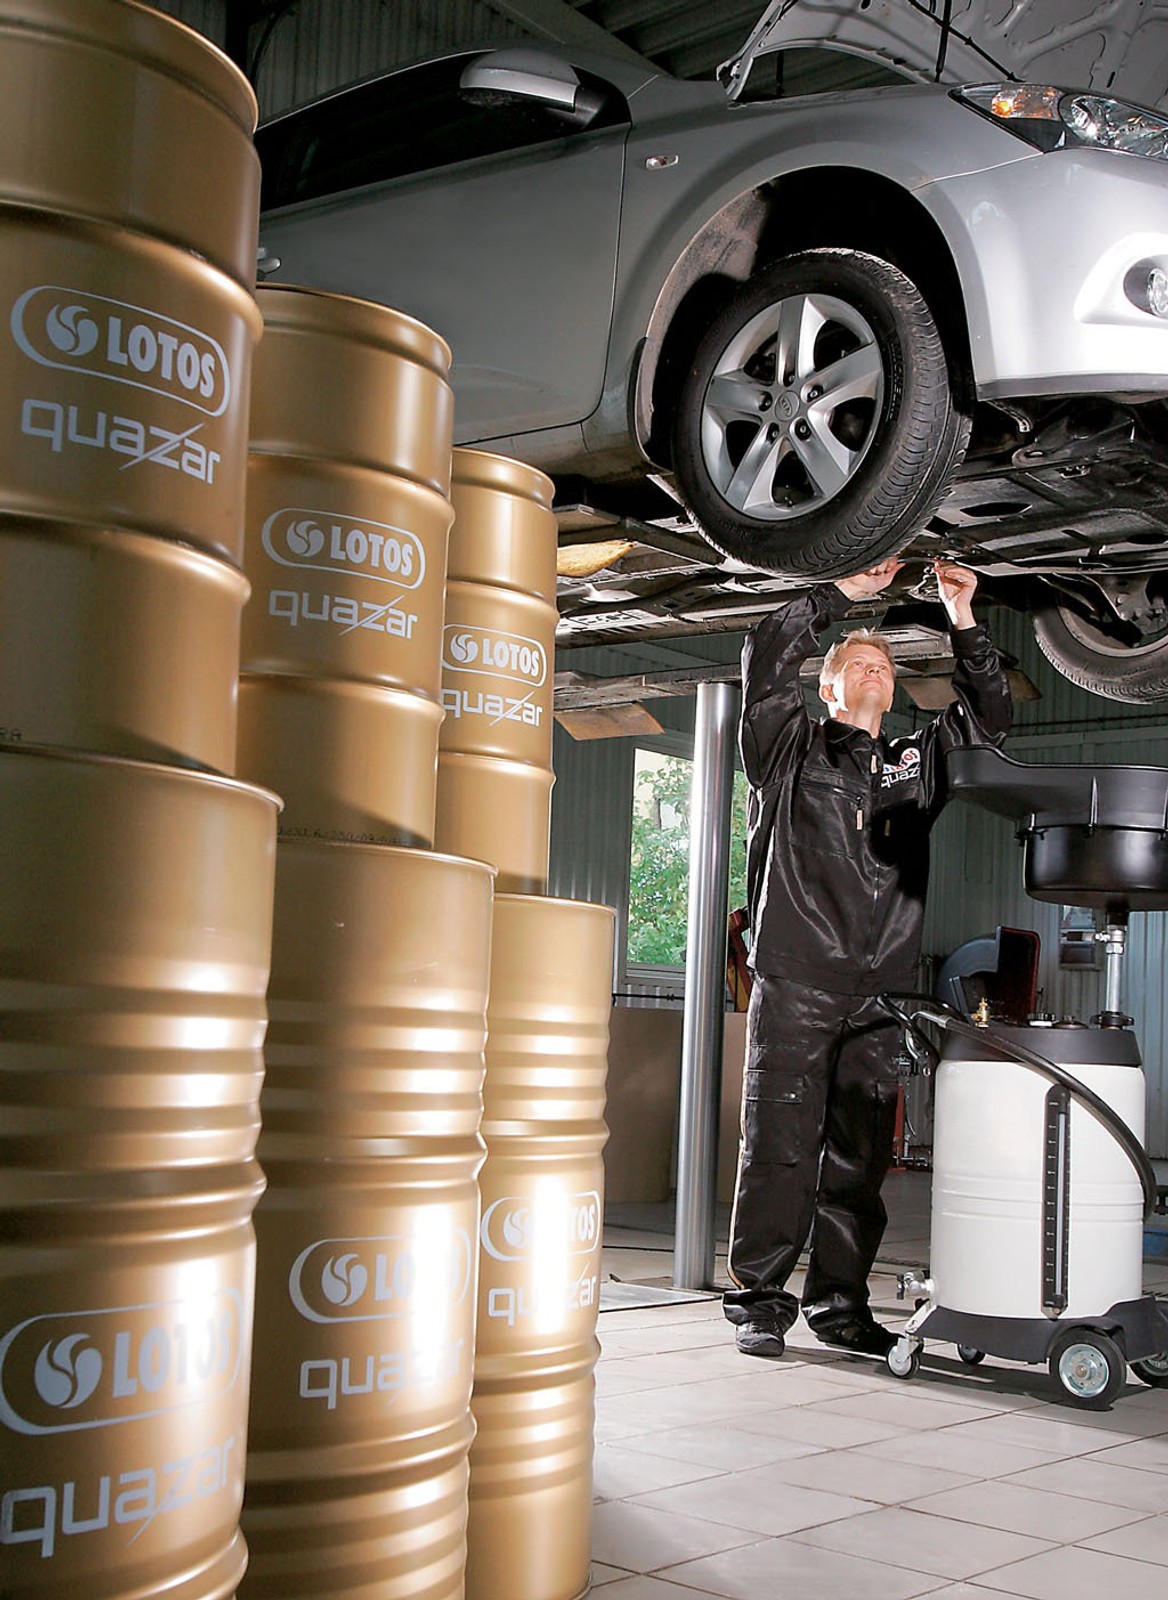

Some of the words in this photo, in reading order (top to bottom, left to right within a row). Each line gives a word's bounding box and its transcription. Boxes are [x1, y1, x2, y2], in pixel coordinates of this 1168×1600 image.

[107, 316, 215, 398] LOTOS
[21, 399, 220, 484] quazar
[330, 525, 413, 576] LOTOS
[269, 590, 418, 639] quazar
[482, 638, 539, 677] LOTOS
[441, 689, 543, 727] quazar
[881, 764, 921, 788] quaz
[0, 1436, 234, 1558] quazar
